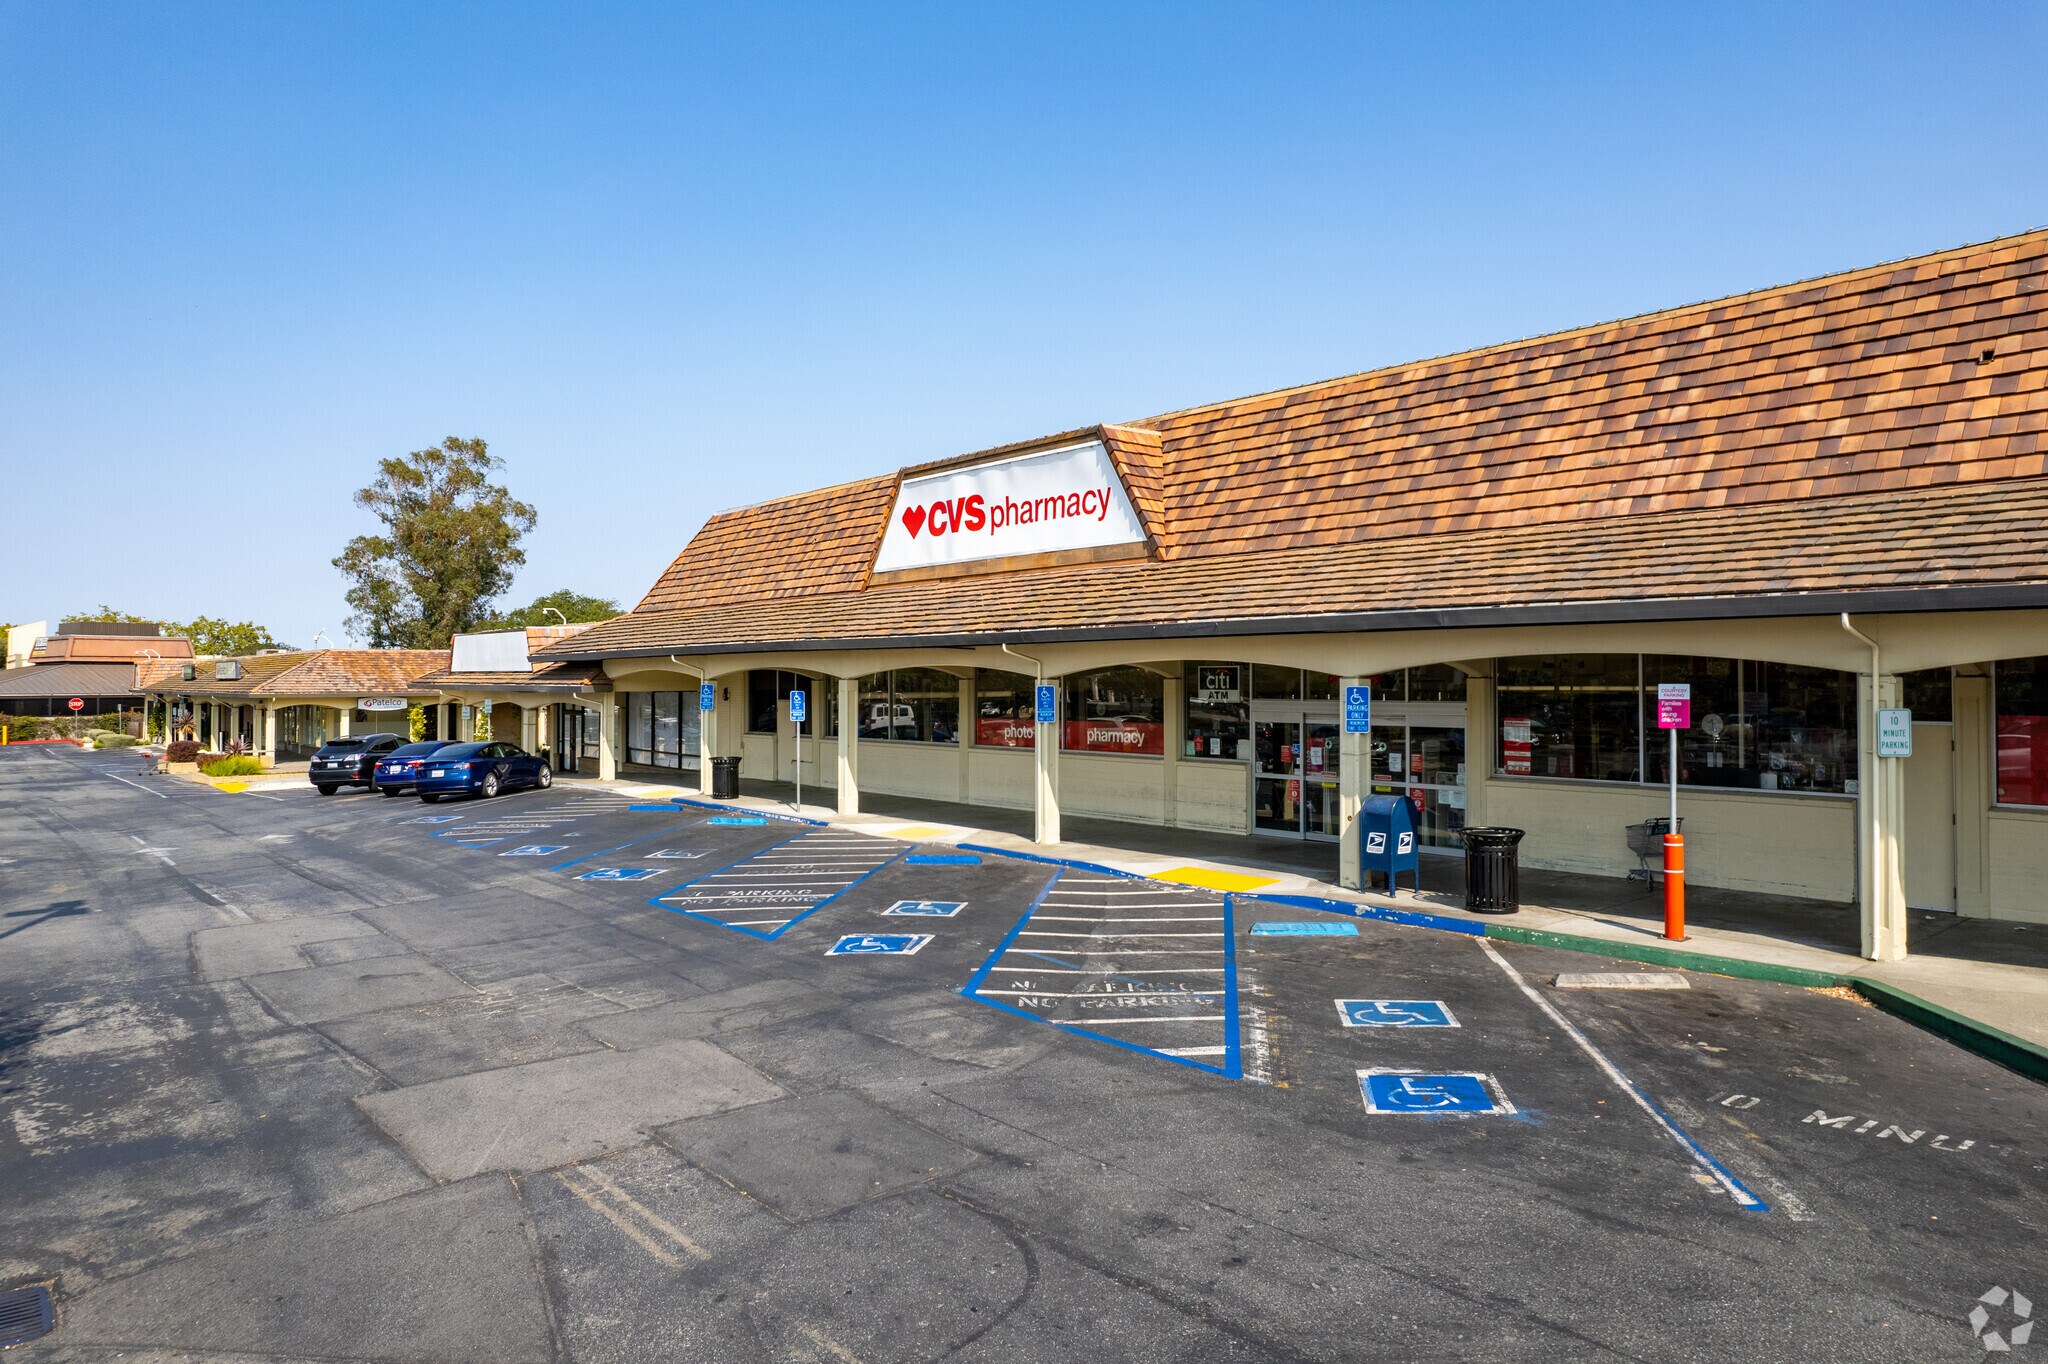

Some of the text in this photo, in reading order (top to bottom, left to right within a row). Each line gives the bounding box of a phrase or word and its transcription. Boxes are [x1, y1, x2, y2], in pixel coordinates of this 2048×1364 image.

[928, 487, 1112, 537] CVS pharmacy
[1206, 672, 1230, 689] citi
[1208, 691, 1229, 699] ATM
[1890, 716, 1899, 725] 10
[1004, 725, 1033, 739] photo
[1087, 727, 1145, 747] pharmacy
[1883, 729, 1906, 737] MINUTE
[1881, 741, 1909, 749] PARKING
